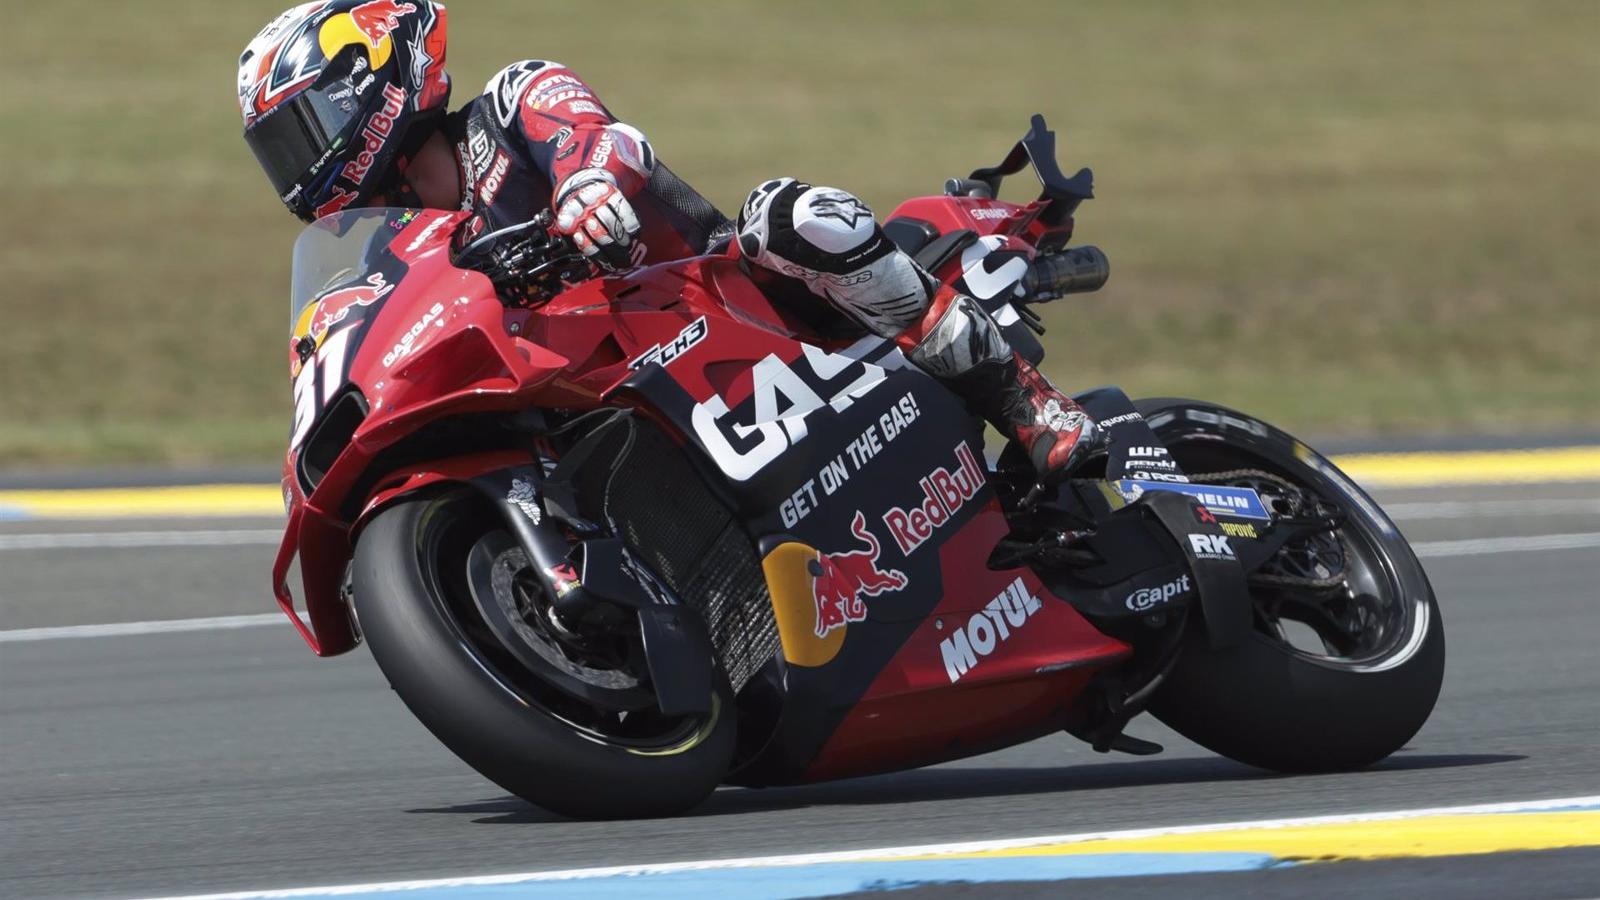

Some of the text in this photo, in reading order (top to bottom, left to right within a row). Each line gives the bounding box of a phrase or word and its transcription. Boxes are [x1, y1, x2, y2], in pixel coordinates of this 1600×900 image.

[588, 132, 614, 168] ASGAS
[480, 154, 510, 205] MOTUL
[382, 302, 445, 368] GASGAS
[1101, 411, 1143, 428] quorum
[779, 391, 922, 529] GET ON THE GAS!
[1125, 459, 1176, 469] pankl
[1128, 446, 1168, 457] WP
[1187, 533, 1234, 555] RK
[939, 576, 1043, 683] MOTUL
